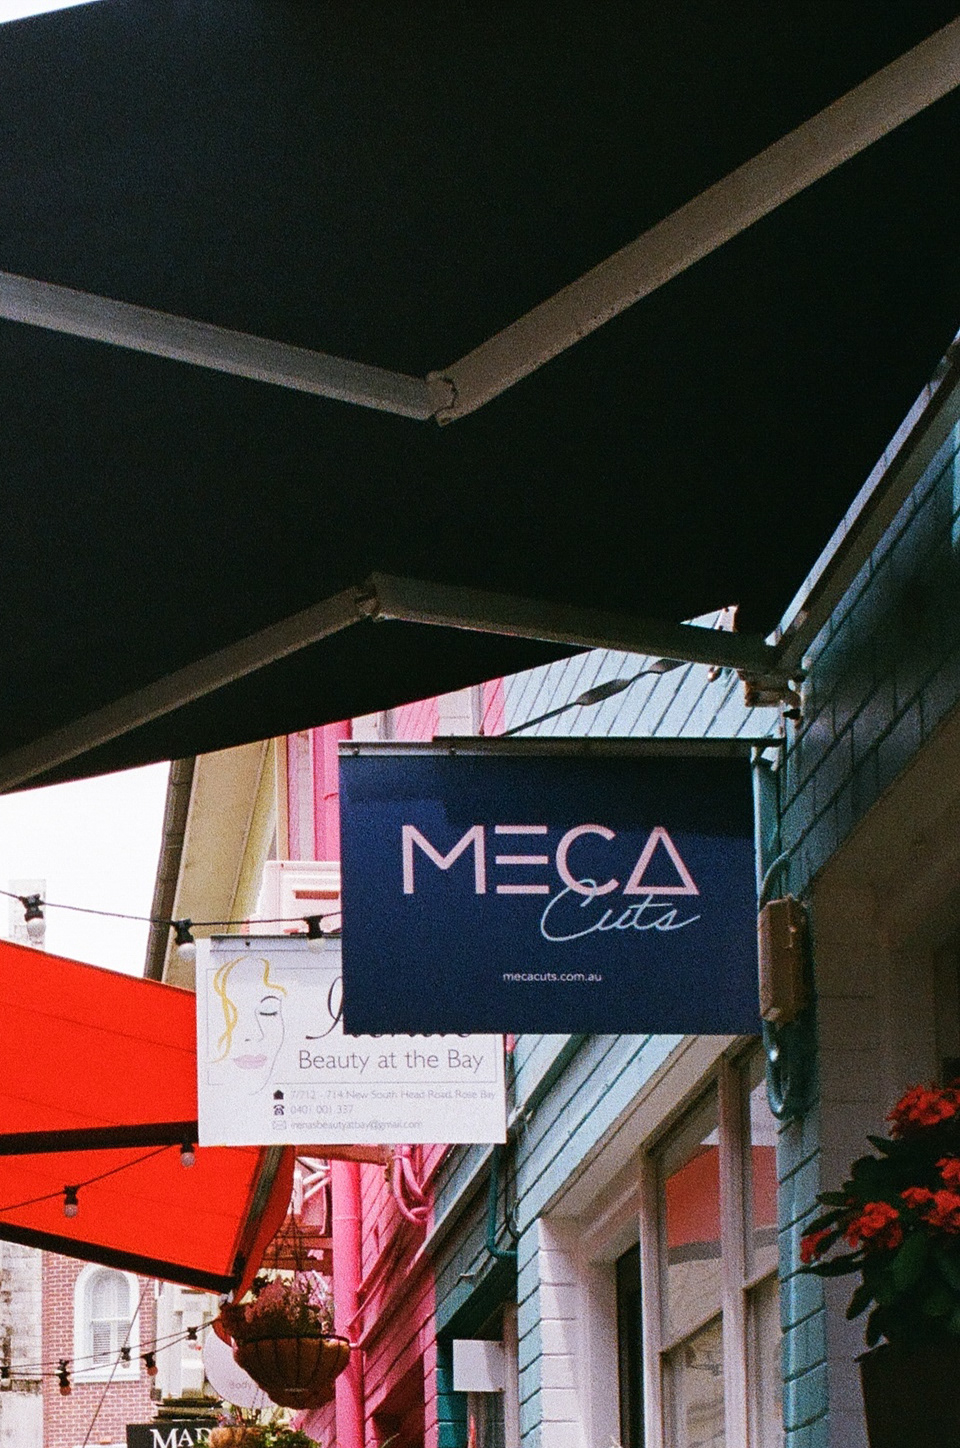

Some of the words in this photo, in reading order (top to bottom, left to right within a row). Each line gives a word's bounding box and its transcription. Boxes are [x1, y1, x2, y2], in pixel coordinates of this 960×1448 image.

[402, 823, 700, 896] MECA
[540, 878, 701, 942] Cuts
[502, 971, 602, 982] mecacuts.com.au
[298, 1049, 370, 1074] Beauty
[377, 1053, 400, 1070] at
[404, 1049, 439, 1069] the
[448, 1048, 485, 1073] Bay
[346, 1090, 368, 1100] New
[371, 1090, 397, 1100] South
[400, 1089, 425, 1099] Head
[455, 1089, 478, 1099] Rose
[480, 1090, 496, 1102] Bay
